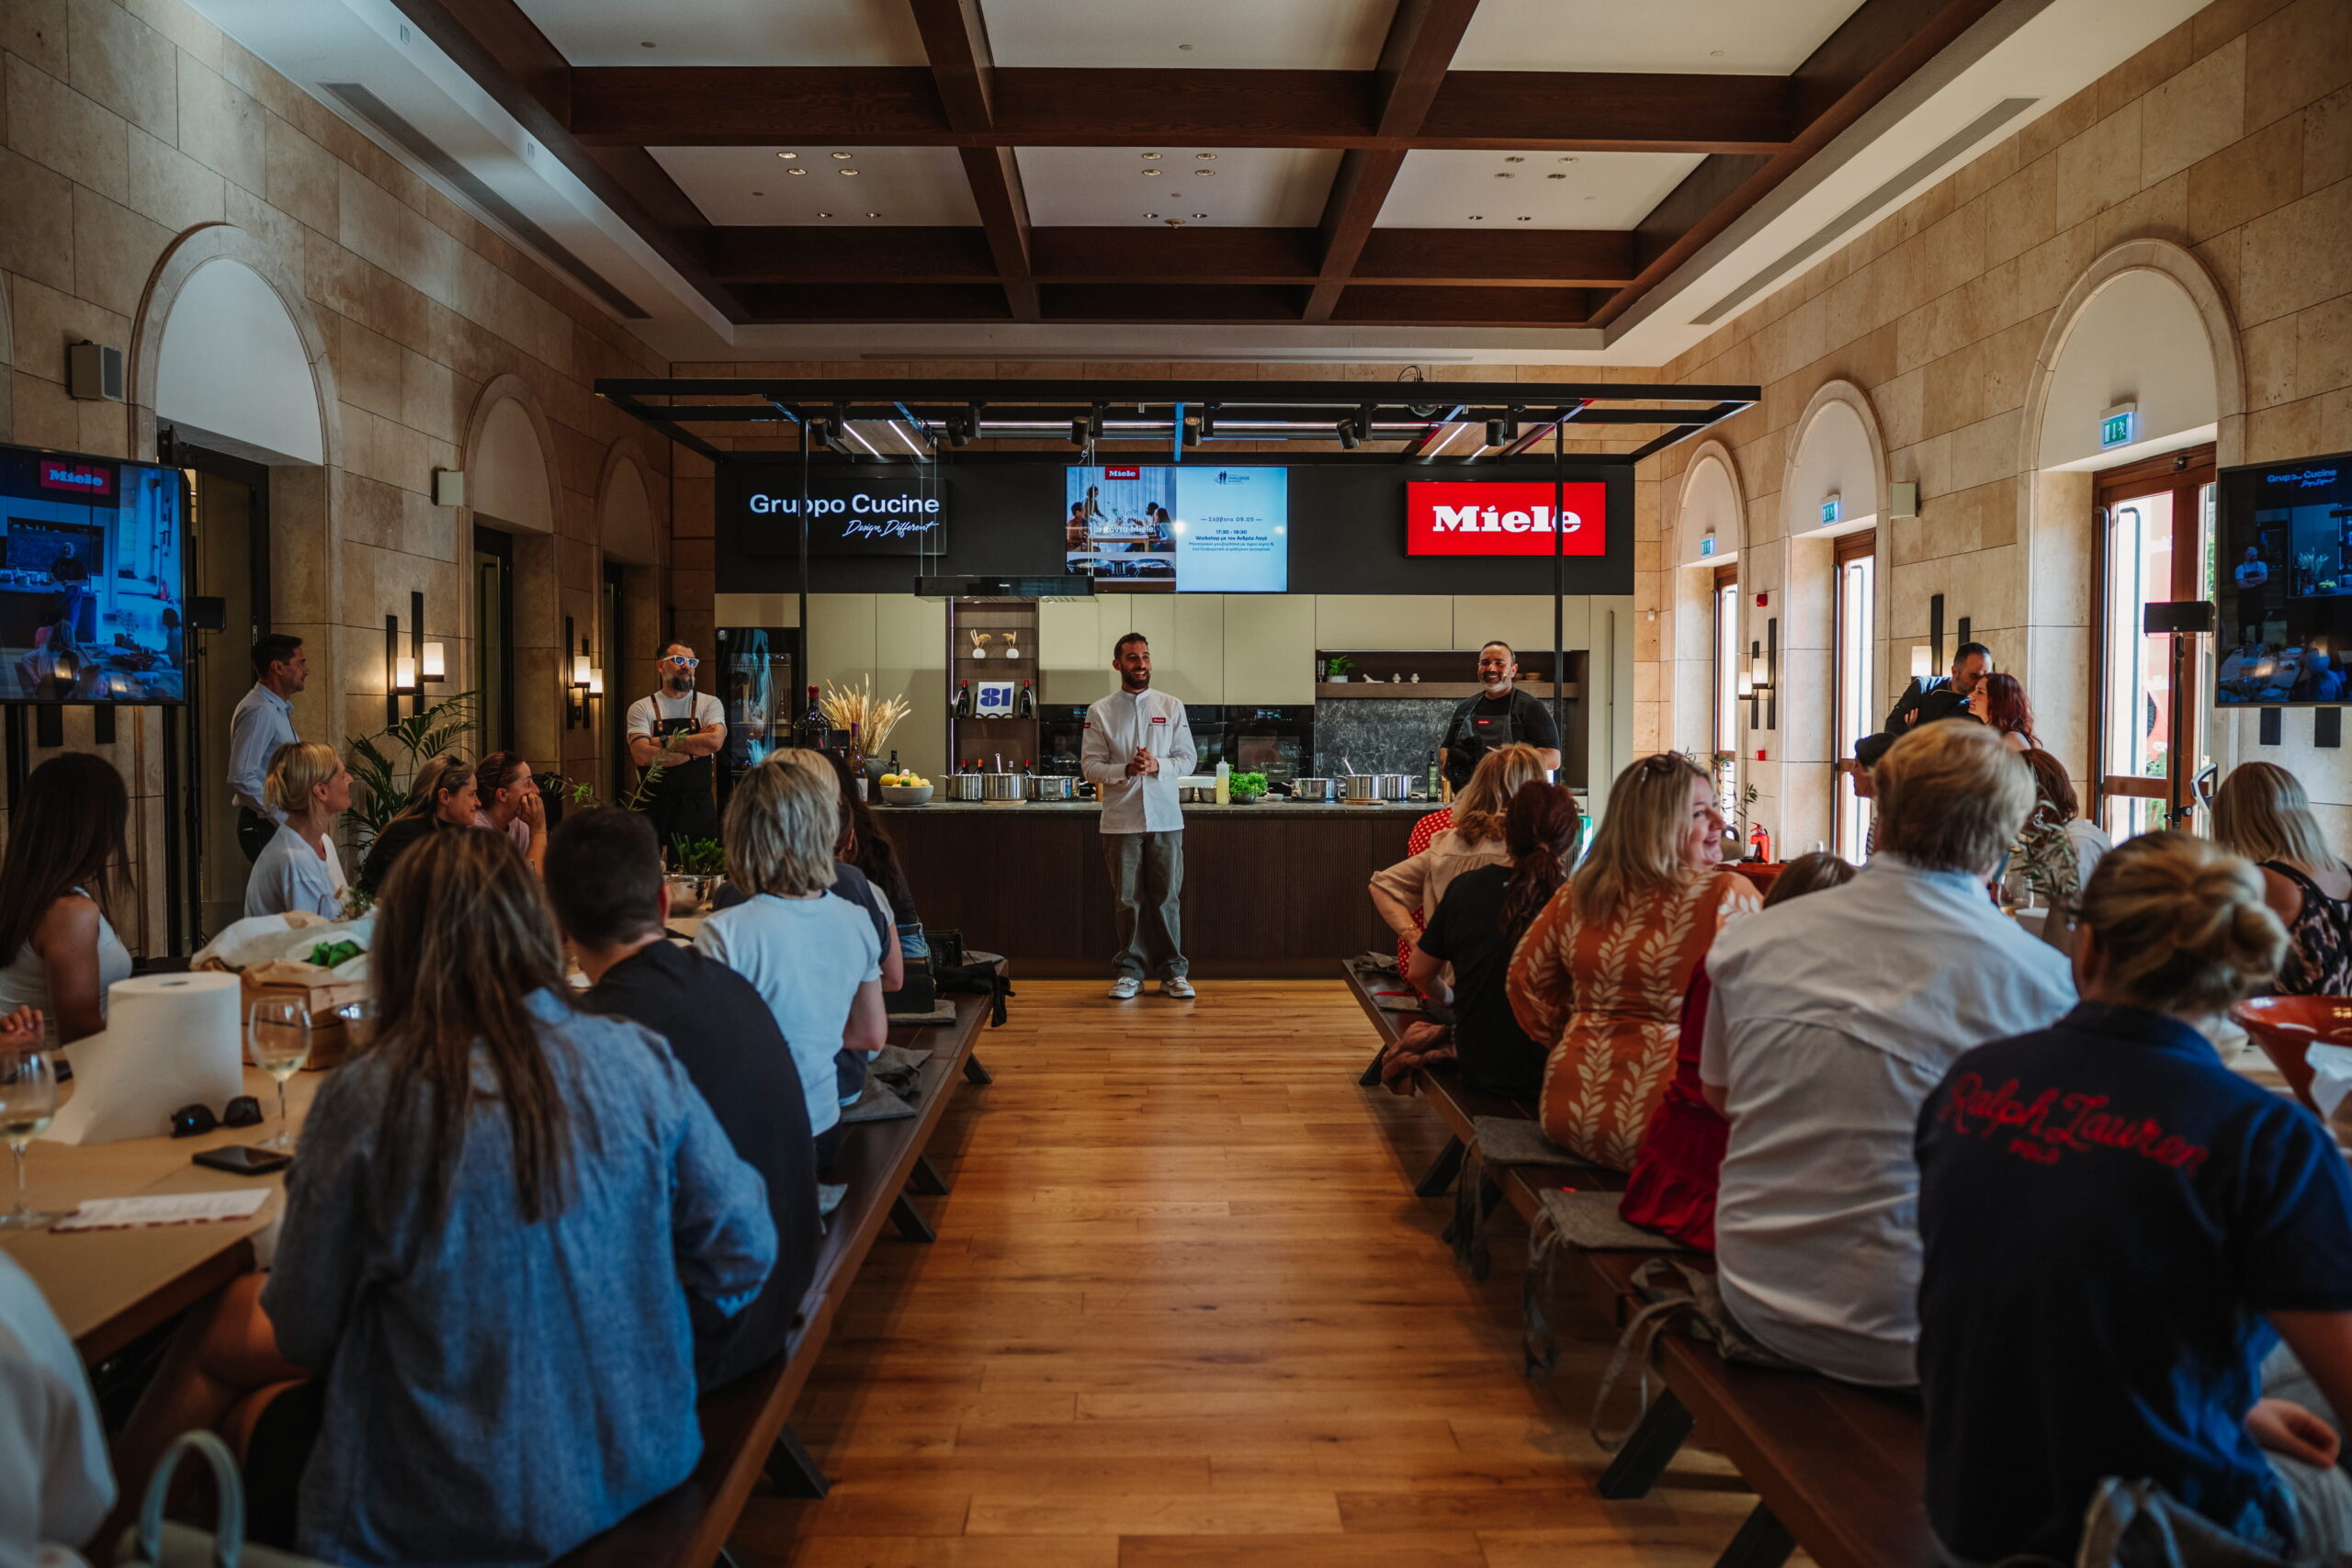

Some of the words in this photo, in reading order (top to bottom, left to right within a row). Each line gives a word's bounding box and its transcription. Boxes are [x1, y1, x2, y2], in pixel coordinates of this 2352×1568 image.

[50, 469, 103, 486] Miele
[853, 494, 939, 513] Cucine
[1432, 505, 1581, 533] Miele
[842, 520, 881, 539] Design
[880, 520, 939, 537] Different
[979, 687, 1012, 707] 81
[1939, 1072, 2060, 1140] Ralph
[2042, 1092, 2209, 1176] Lauren
